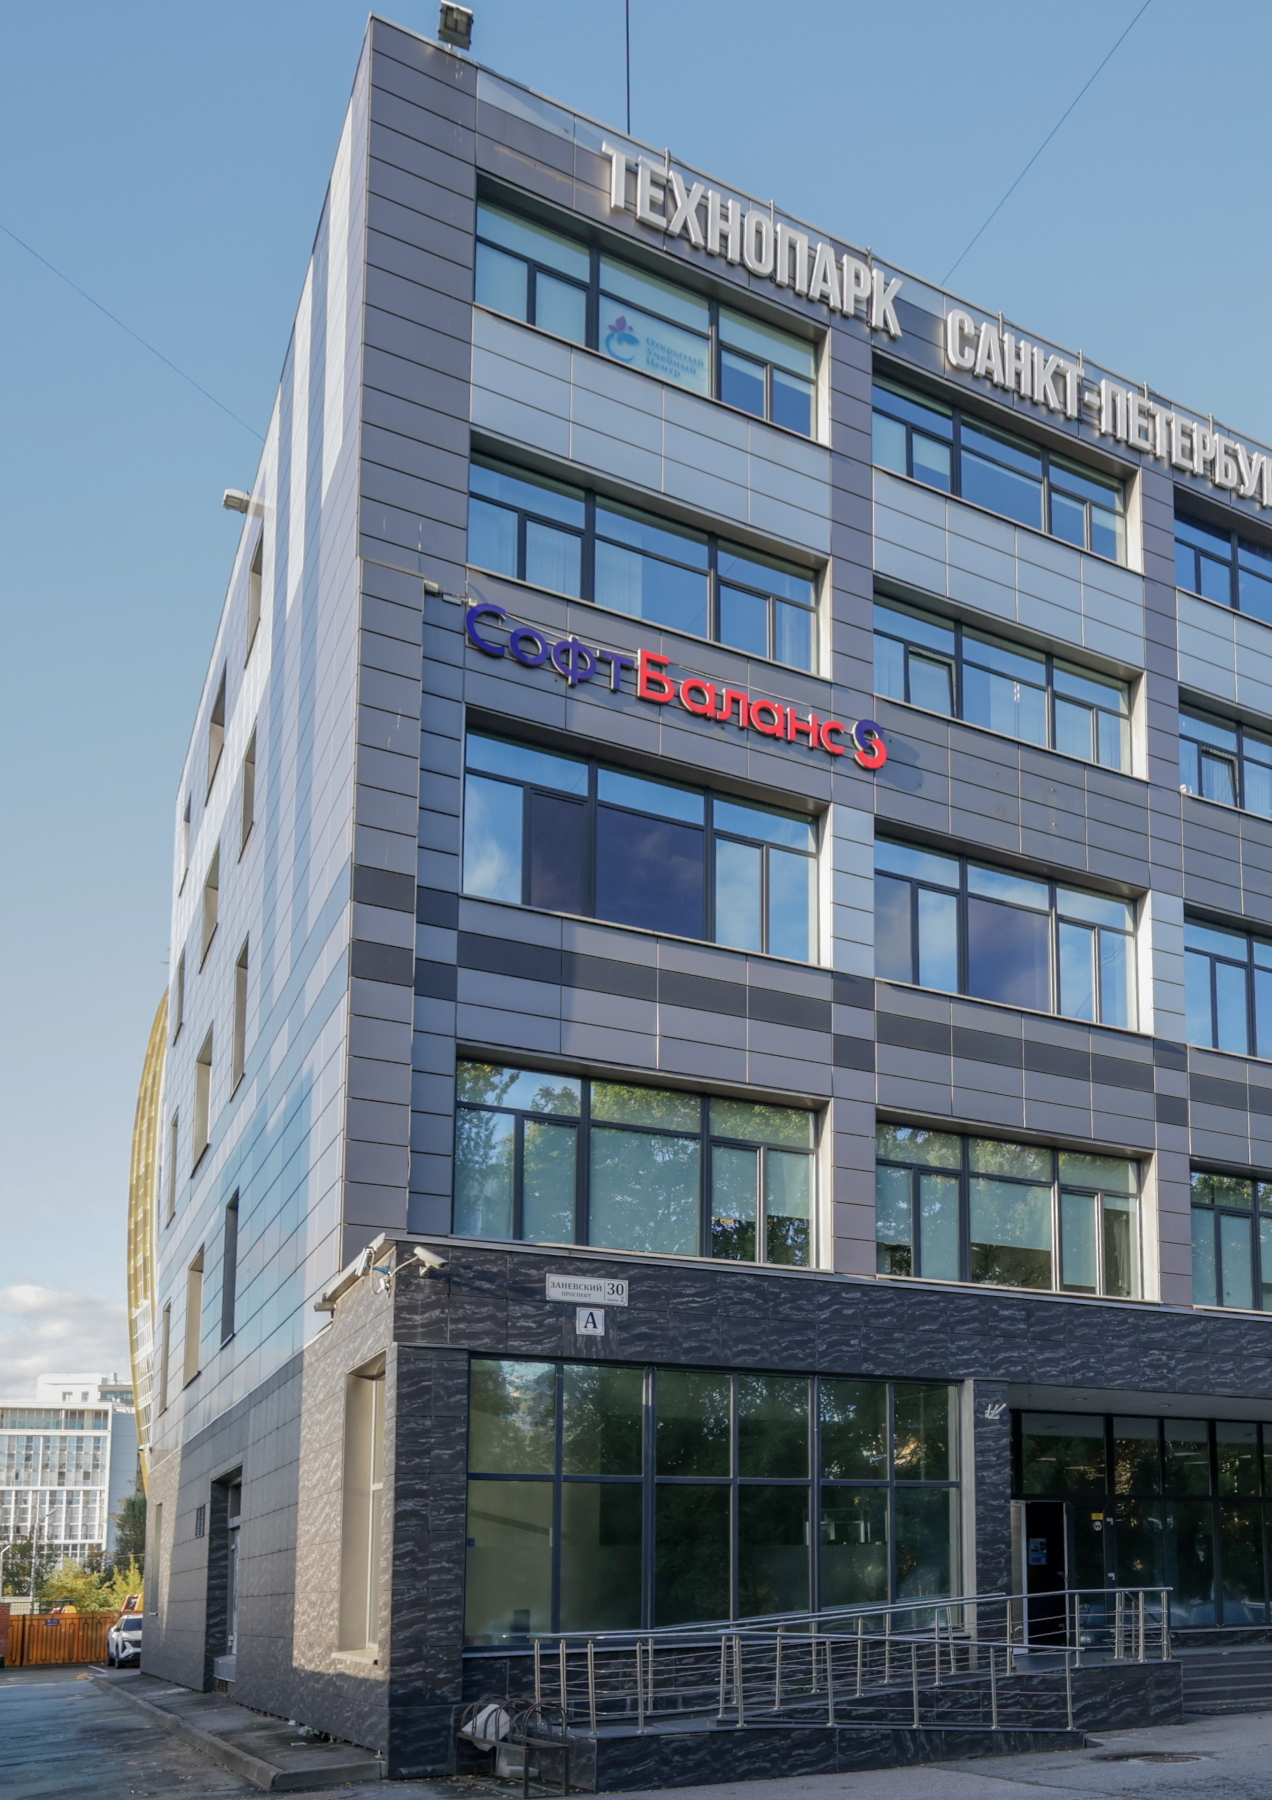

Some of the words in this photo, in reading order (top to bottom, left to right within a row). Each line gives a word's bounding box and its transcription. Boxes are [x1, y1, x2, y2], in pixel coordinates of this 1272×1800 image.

[602, 141, 902, 337] ТЕХНОПАРК
[465, 603, 845, 756] СофтБаланс
[550, 1281, 602, 1292] ЗАНЕВСКИЙ
[607, 1283, 624, 1296] 30
[583, 1312, 598, 1329] А
